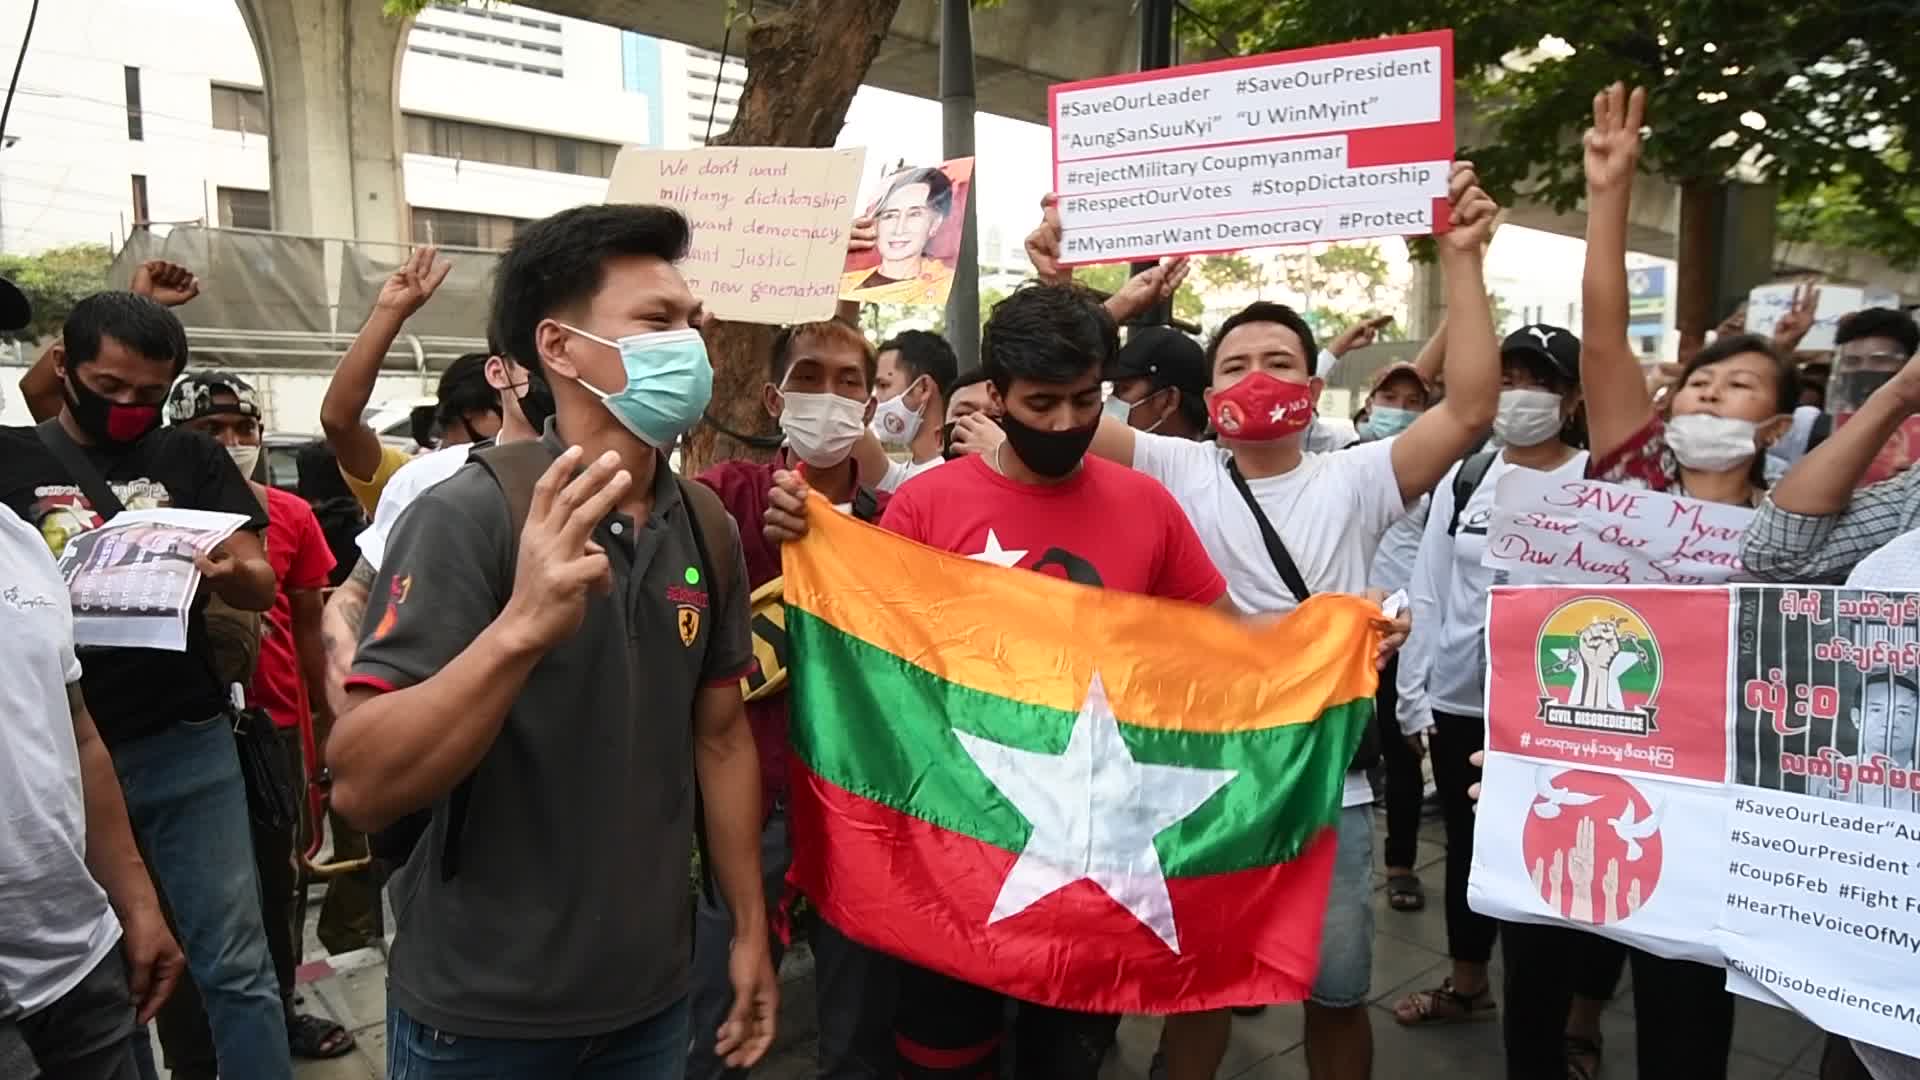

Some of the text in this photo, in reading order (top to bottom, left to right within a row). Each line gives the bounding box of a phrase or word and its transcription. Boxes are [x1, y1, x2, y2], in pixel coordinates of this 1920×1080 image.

[1060, 58, 1432, 118] #SaveOurLeader #SaveOurPresident
[659, 157, 689, 177] We
[749, 160, 787, 177] want
[1067, 146, 1343, 187] #rejectMilitary Coupmyanmar
[1067, 167, 1431, 214] #RespectOurVotes #StopDictatorship
[1067, 228, 1212, 255] #MyanmarWant
[1216, 216, 1323, 241] Democracy
[710, 278, 744, 296] new
[1543, 482, 1649, 520] SAVE
[1599, 524, 1650, 549] Our
[1490, 532, 1558, 566] Daw
[1563, 541, 1631, 584] Aung
[1549, 708, 1645, 732] CIVIL DISOBEDIENCE
[1731, 829, 1909, 876] #SaveOurPresident
[1729, 861, 1920, 915] #Coup6Feb #Fight F
